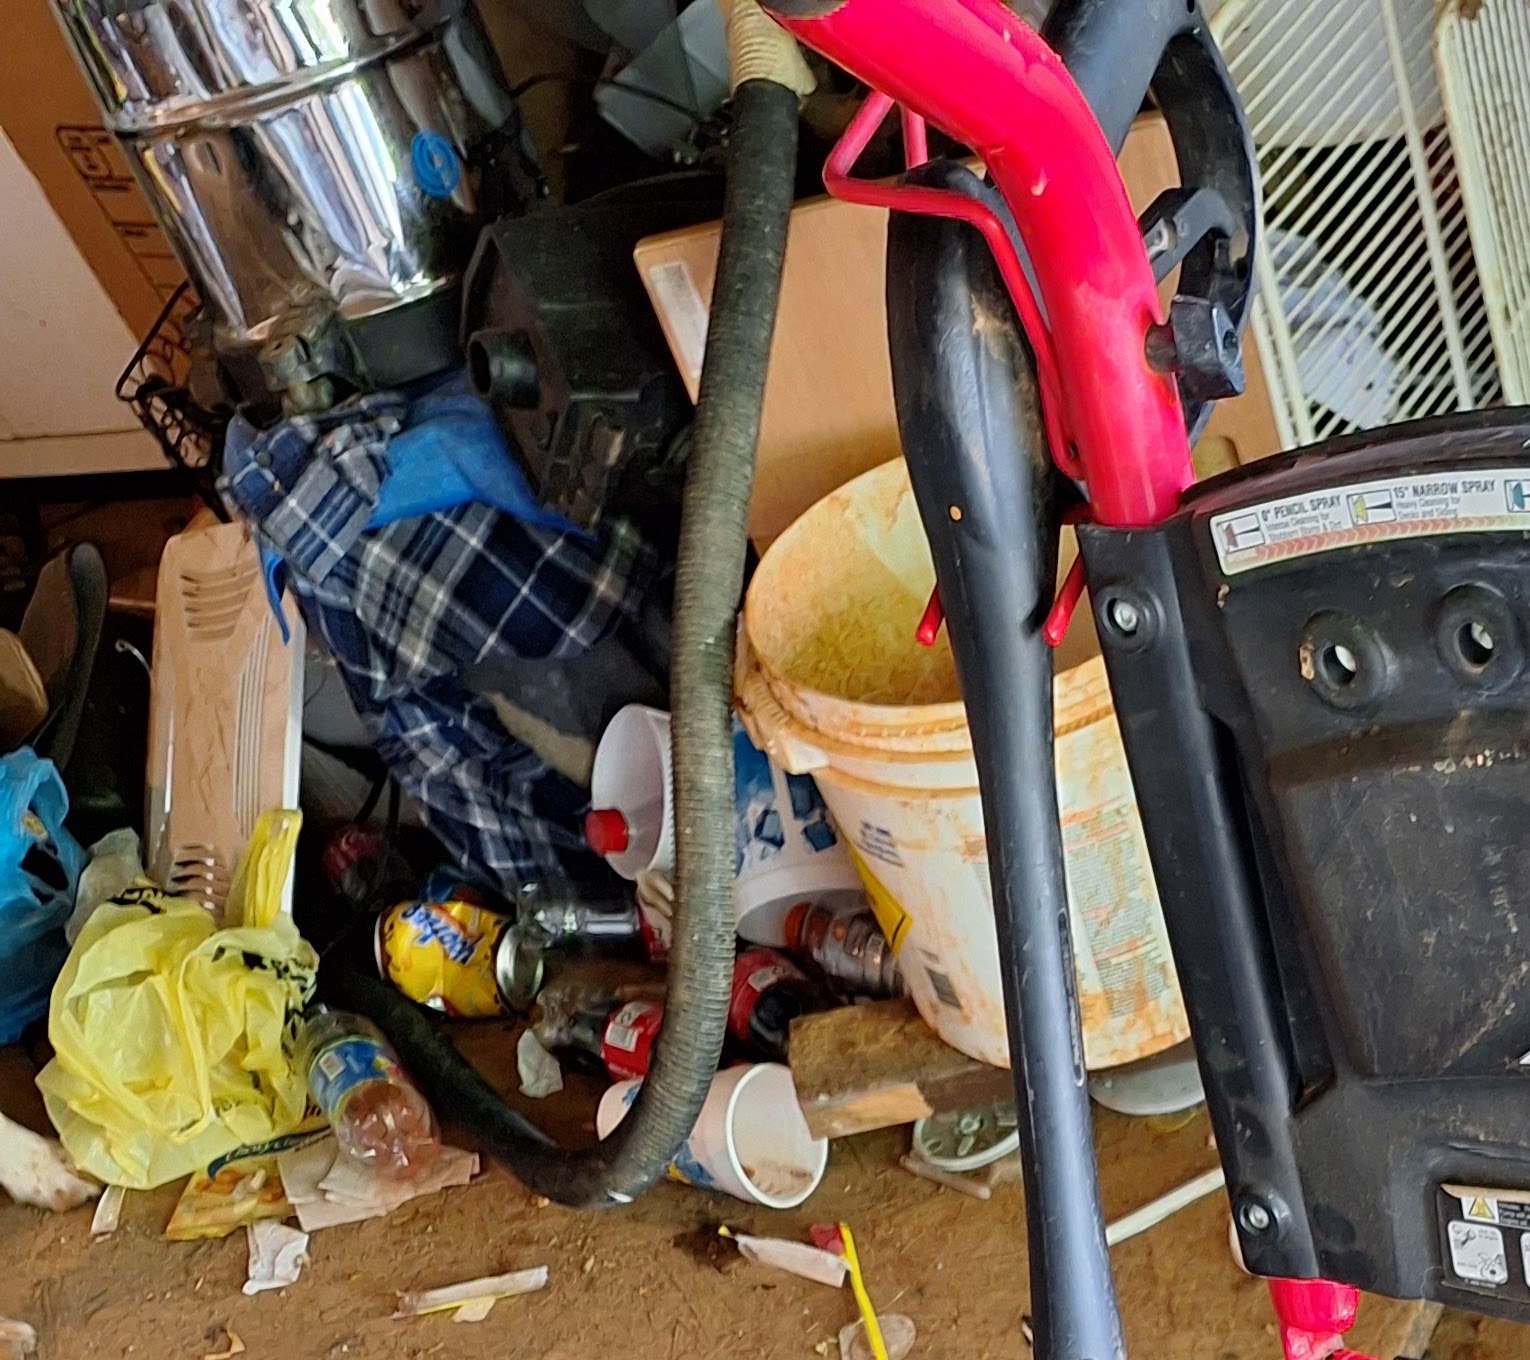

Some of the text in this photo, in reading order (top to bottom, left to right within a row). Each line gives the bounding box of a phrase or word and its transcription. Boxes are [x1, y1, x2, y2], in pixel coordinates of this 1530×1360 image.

[1411, 479, 1459, 498] NARROW
[1461, 479, 1496, 493] SPRAY
[1273, 494, 1342, 519] PENCIL SPRAY
